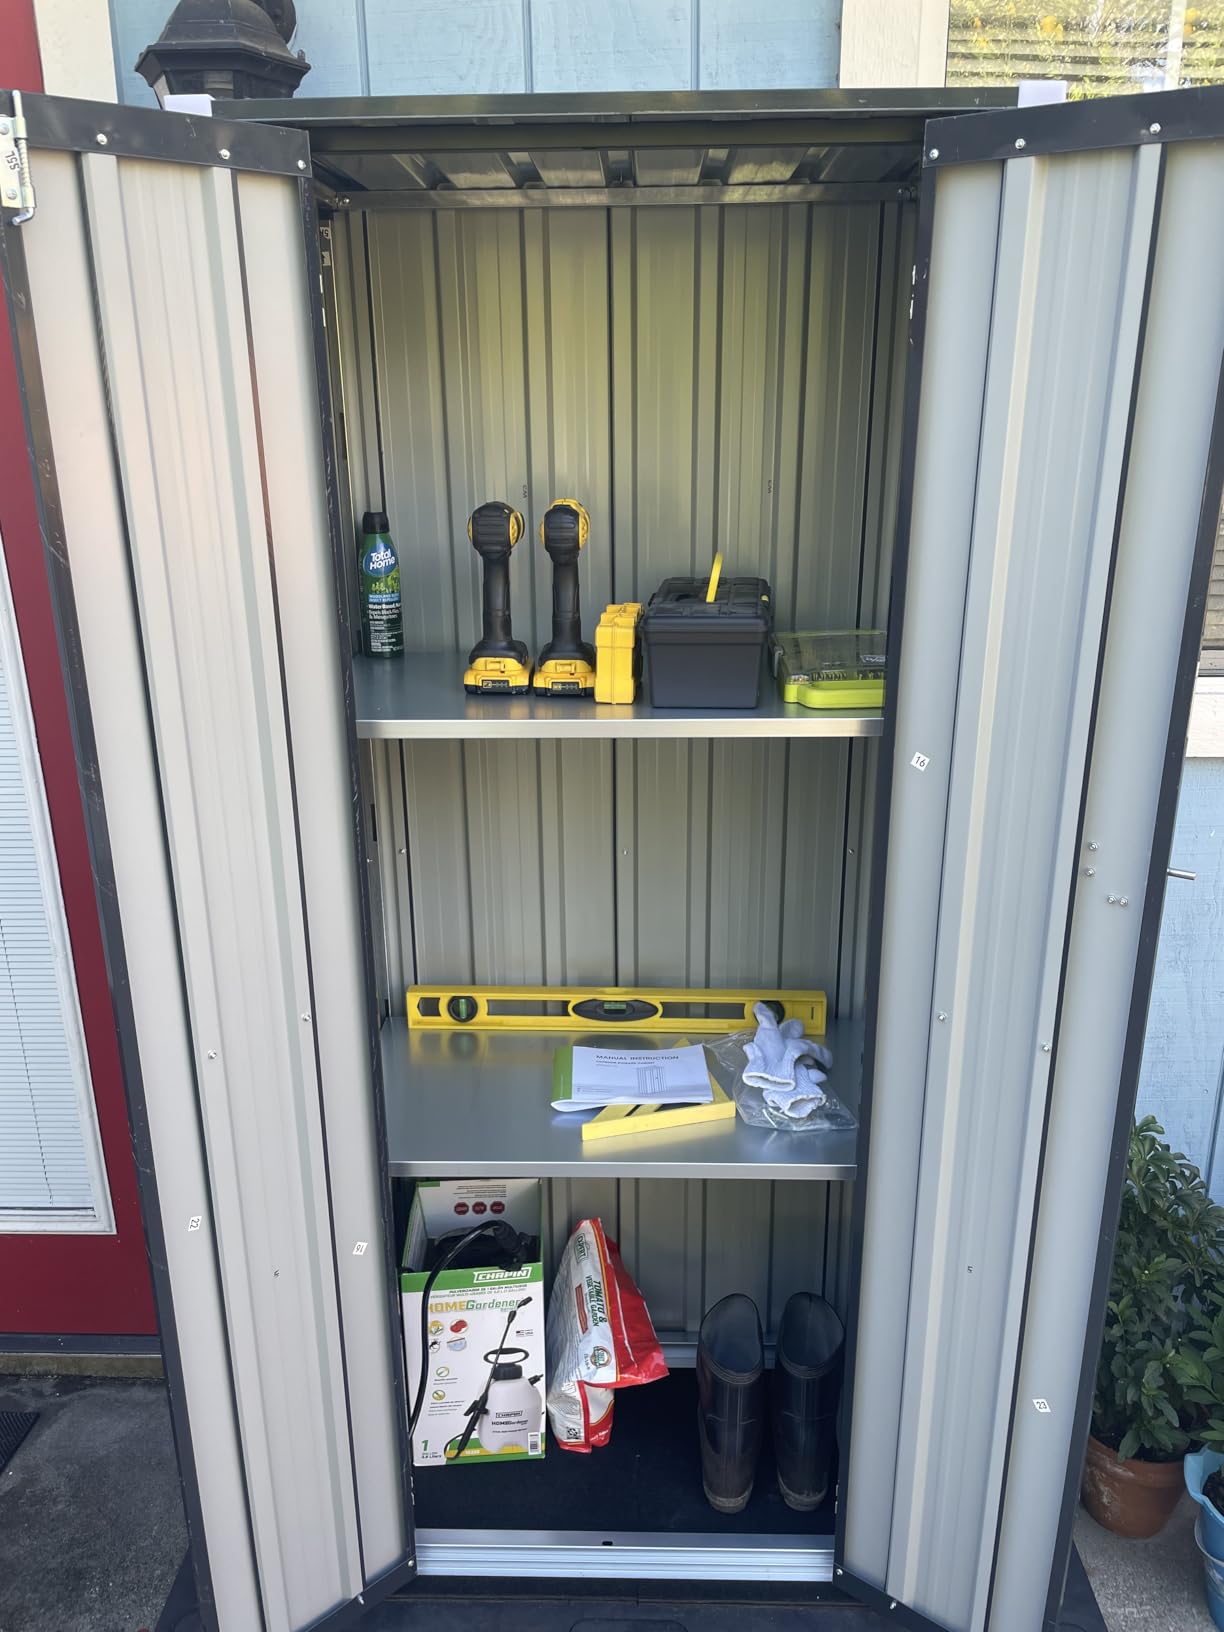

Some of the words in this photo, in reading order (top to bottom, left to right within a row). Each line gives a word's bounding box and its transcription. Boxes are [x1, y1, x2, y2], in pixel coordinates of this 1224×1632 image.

[370, 548, 392, 562] Total
[369, 556, 396, 570] Home
[915, 755, 926, 768] 16
[189, 1217, 200, 1230] 22
[478, 1268, 528, 1281] CHAPIN
[585, 1275, 596, 1304] VEGETABLE
[593, 1280, 606, 1314] TOMATO
[590, 1304, 600, 1327] GARDEN
[599, 1315, 607, 1323] &
[1036, 1401, 1048, 1410] 23
[421, 1439, 429, 1451] 1
